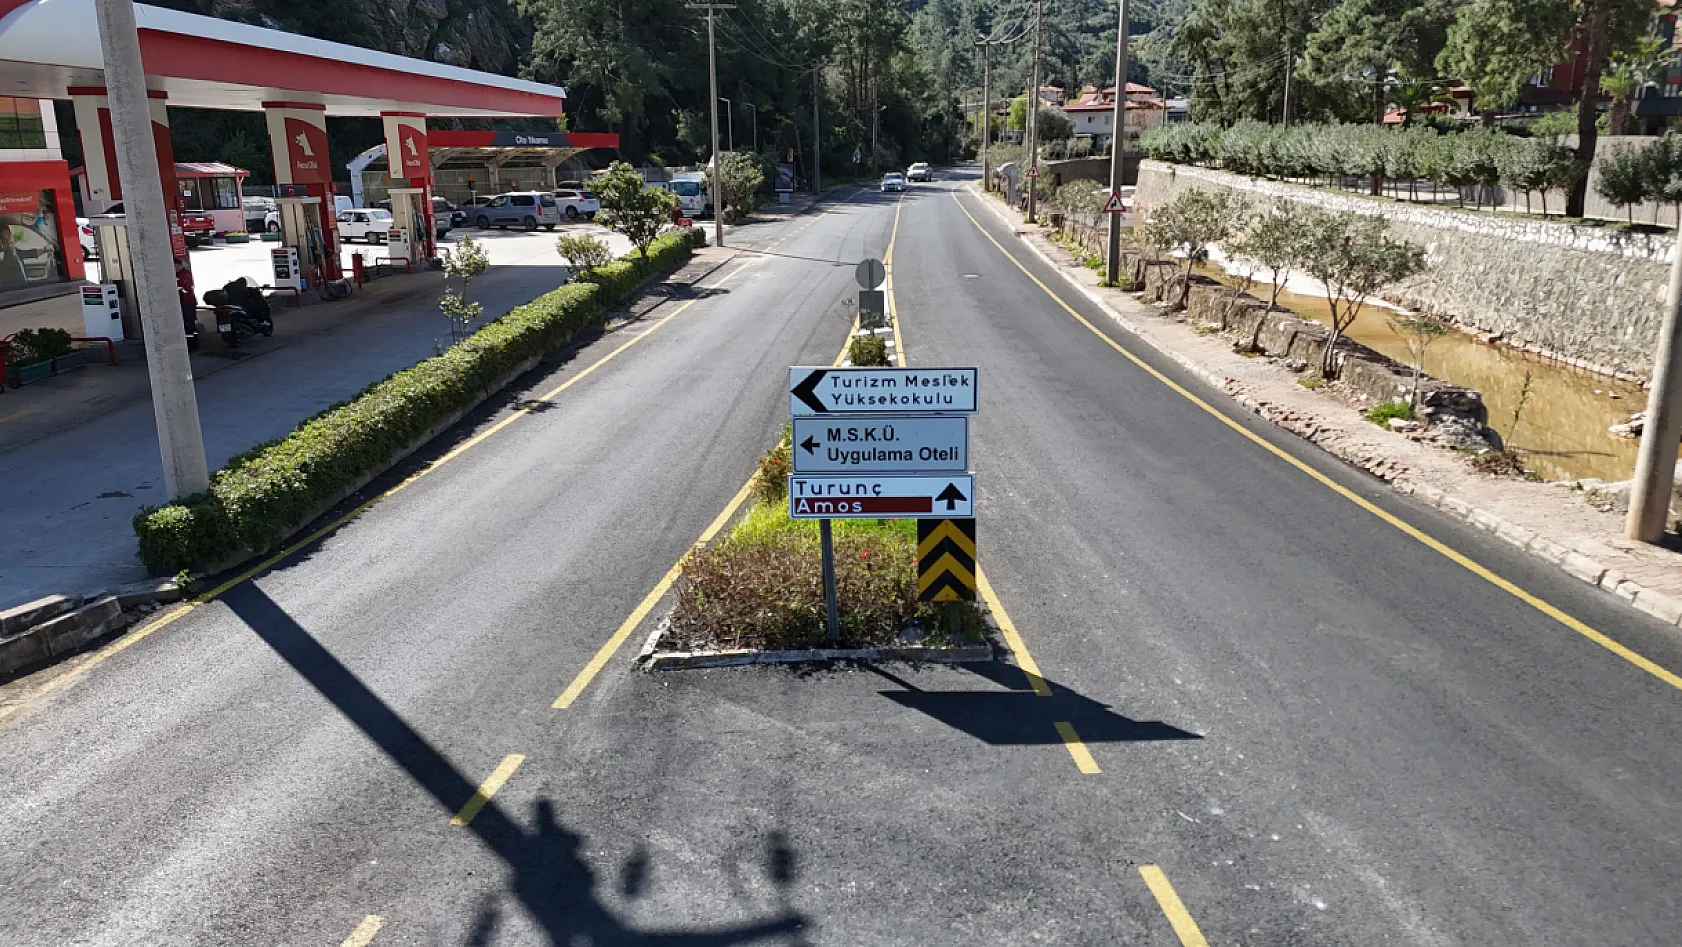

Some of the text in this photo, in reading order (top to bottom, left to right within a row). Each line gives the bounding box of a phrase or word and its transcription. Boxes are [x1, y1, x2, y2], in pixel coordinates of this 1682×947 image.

[831, 376, 897, 388] Turizm
[831, 392, 953, 405] Yüksekokulu
[827, 424, 900, 442] M.S.K.Ü.
[827, 446, 959, 465] Uygulama Oteli
[795, 480, 882, 497] Turunç
[796, 498, 863, 513] Amos
